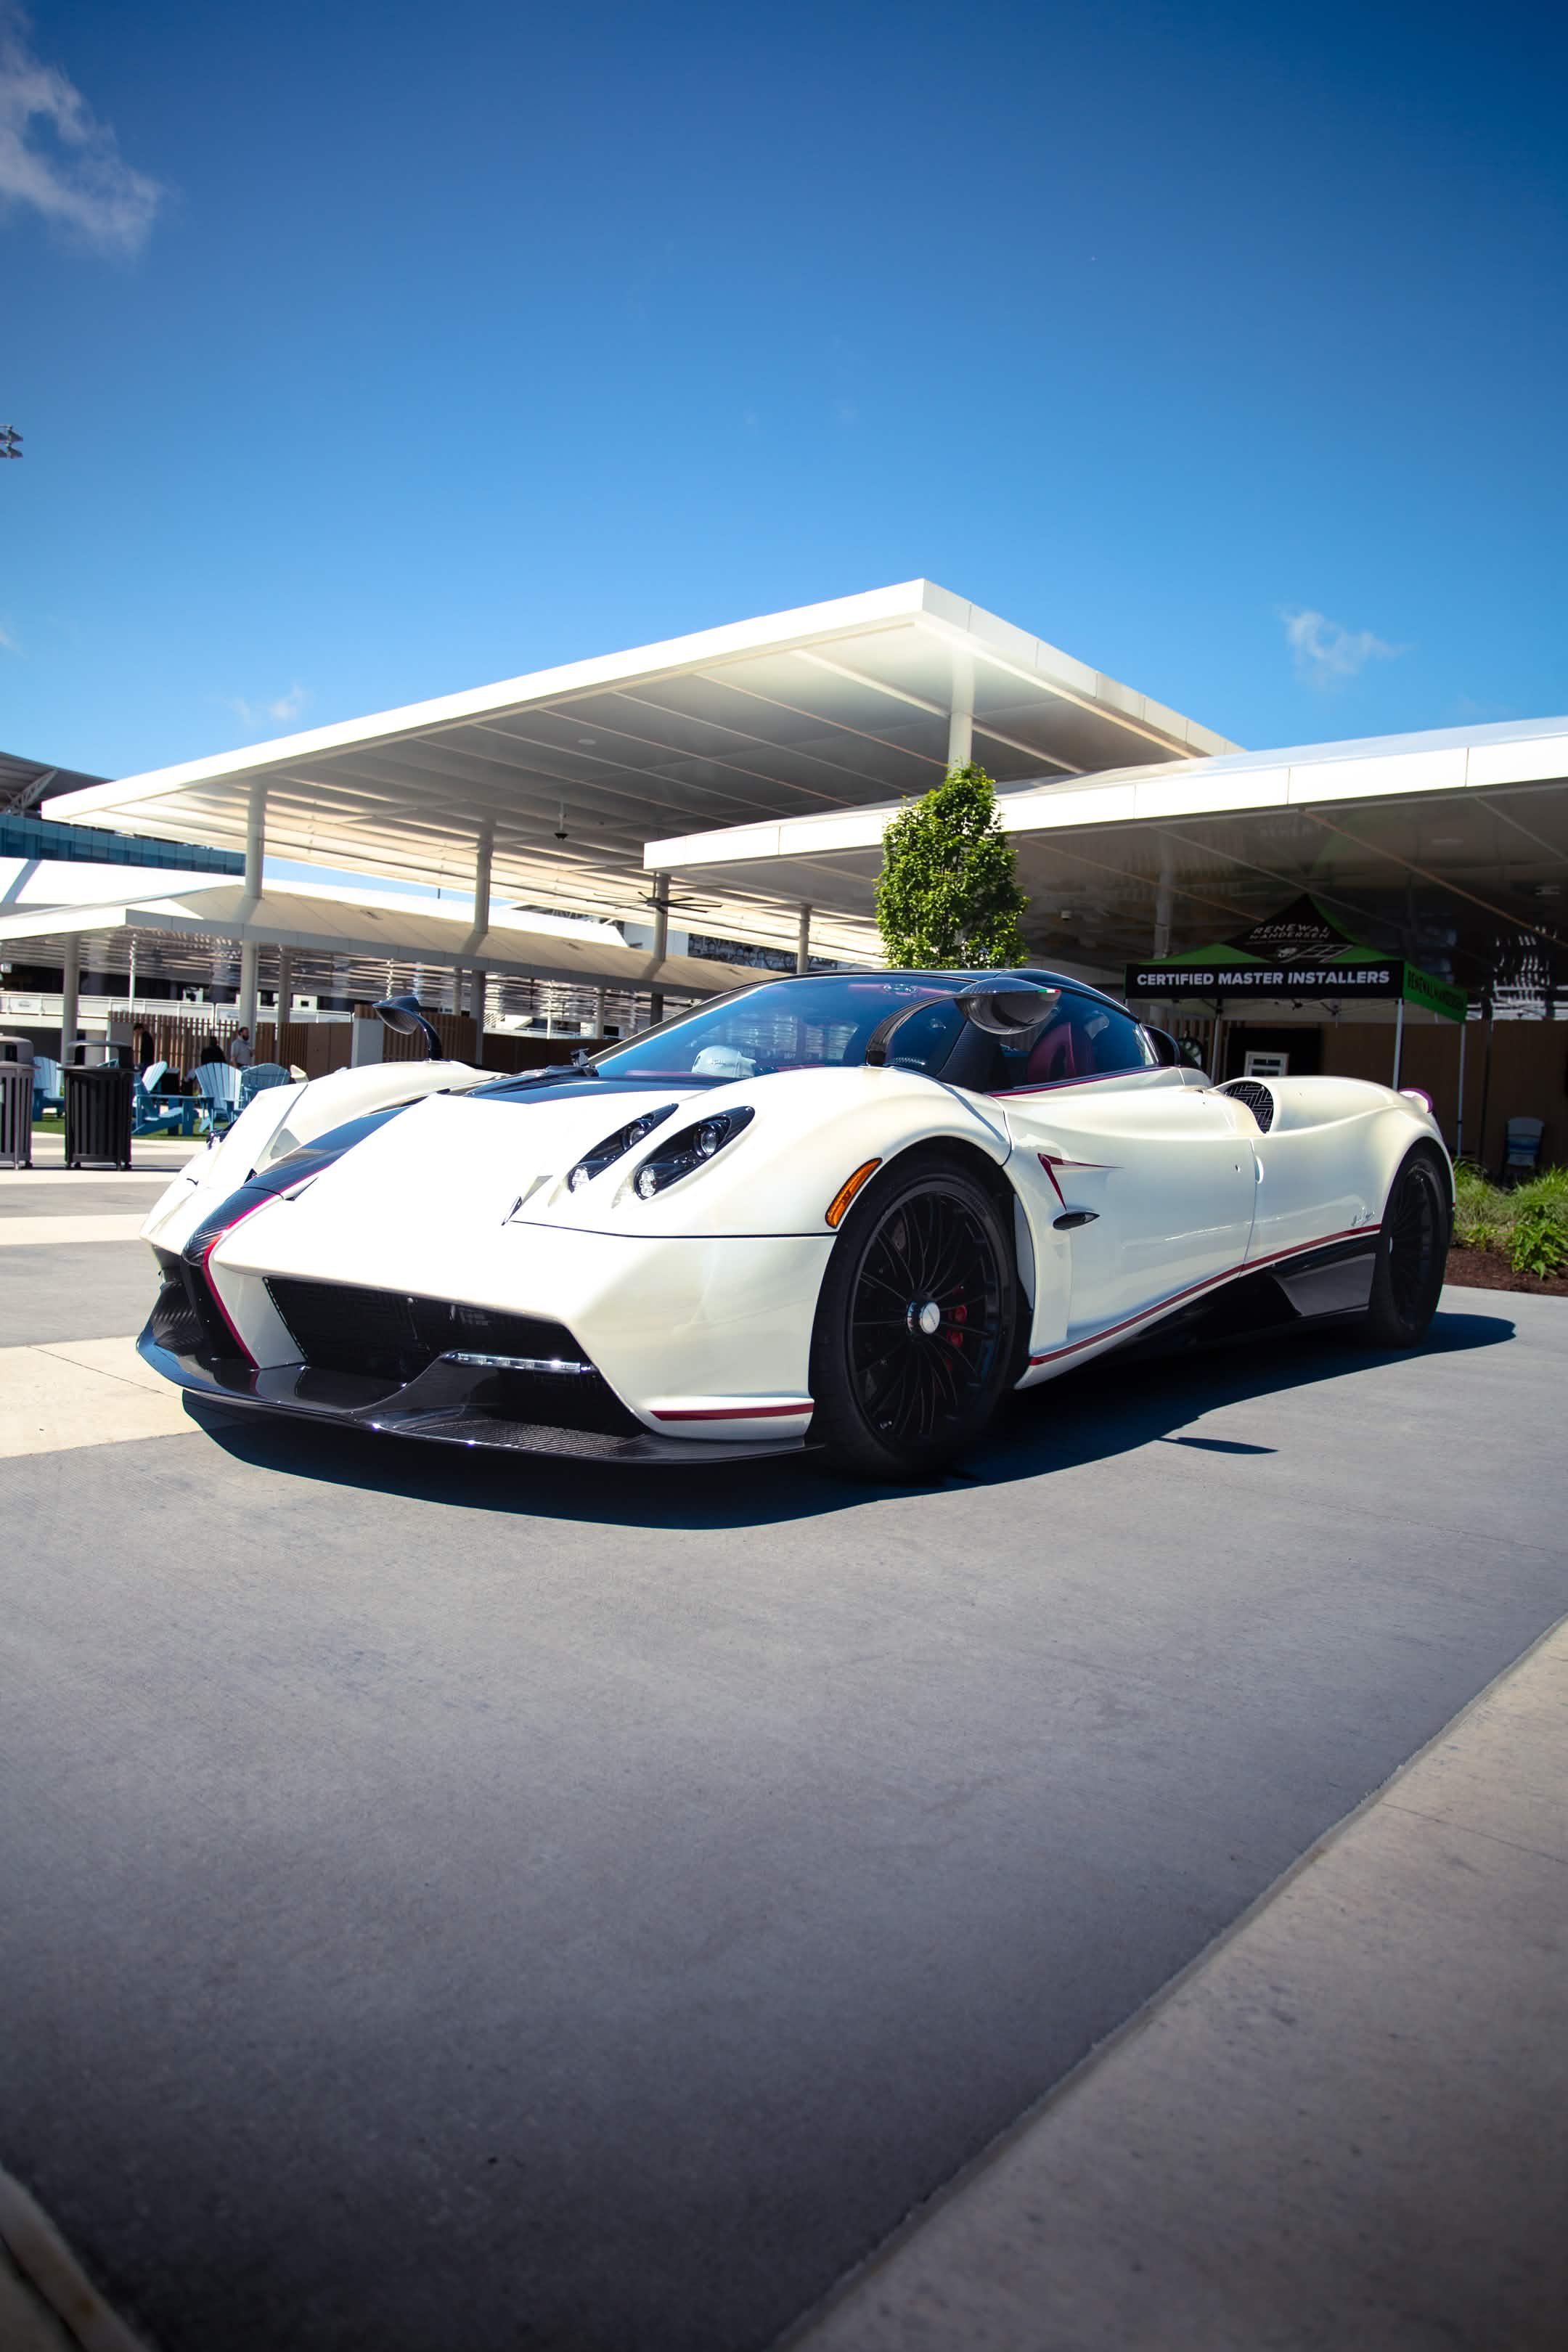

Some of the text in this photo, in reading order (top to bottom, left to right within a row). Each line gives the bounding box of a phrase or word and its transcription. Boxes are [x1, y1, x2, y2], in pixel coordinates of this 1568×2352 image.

[1254, 924, 1329, 934] RENEWAL
[1137, 971, 1389, 985] CERTIFIED MASTER INSTALLERS
